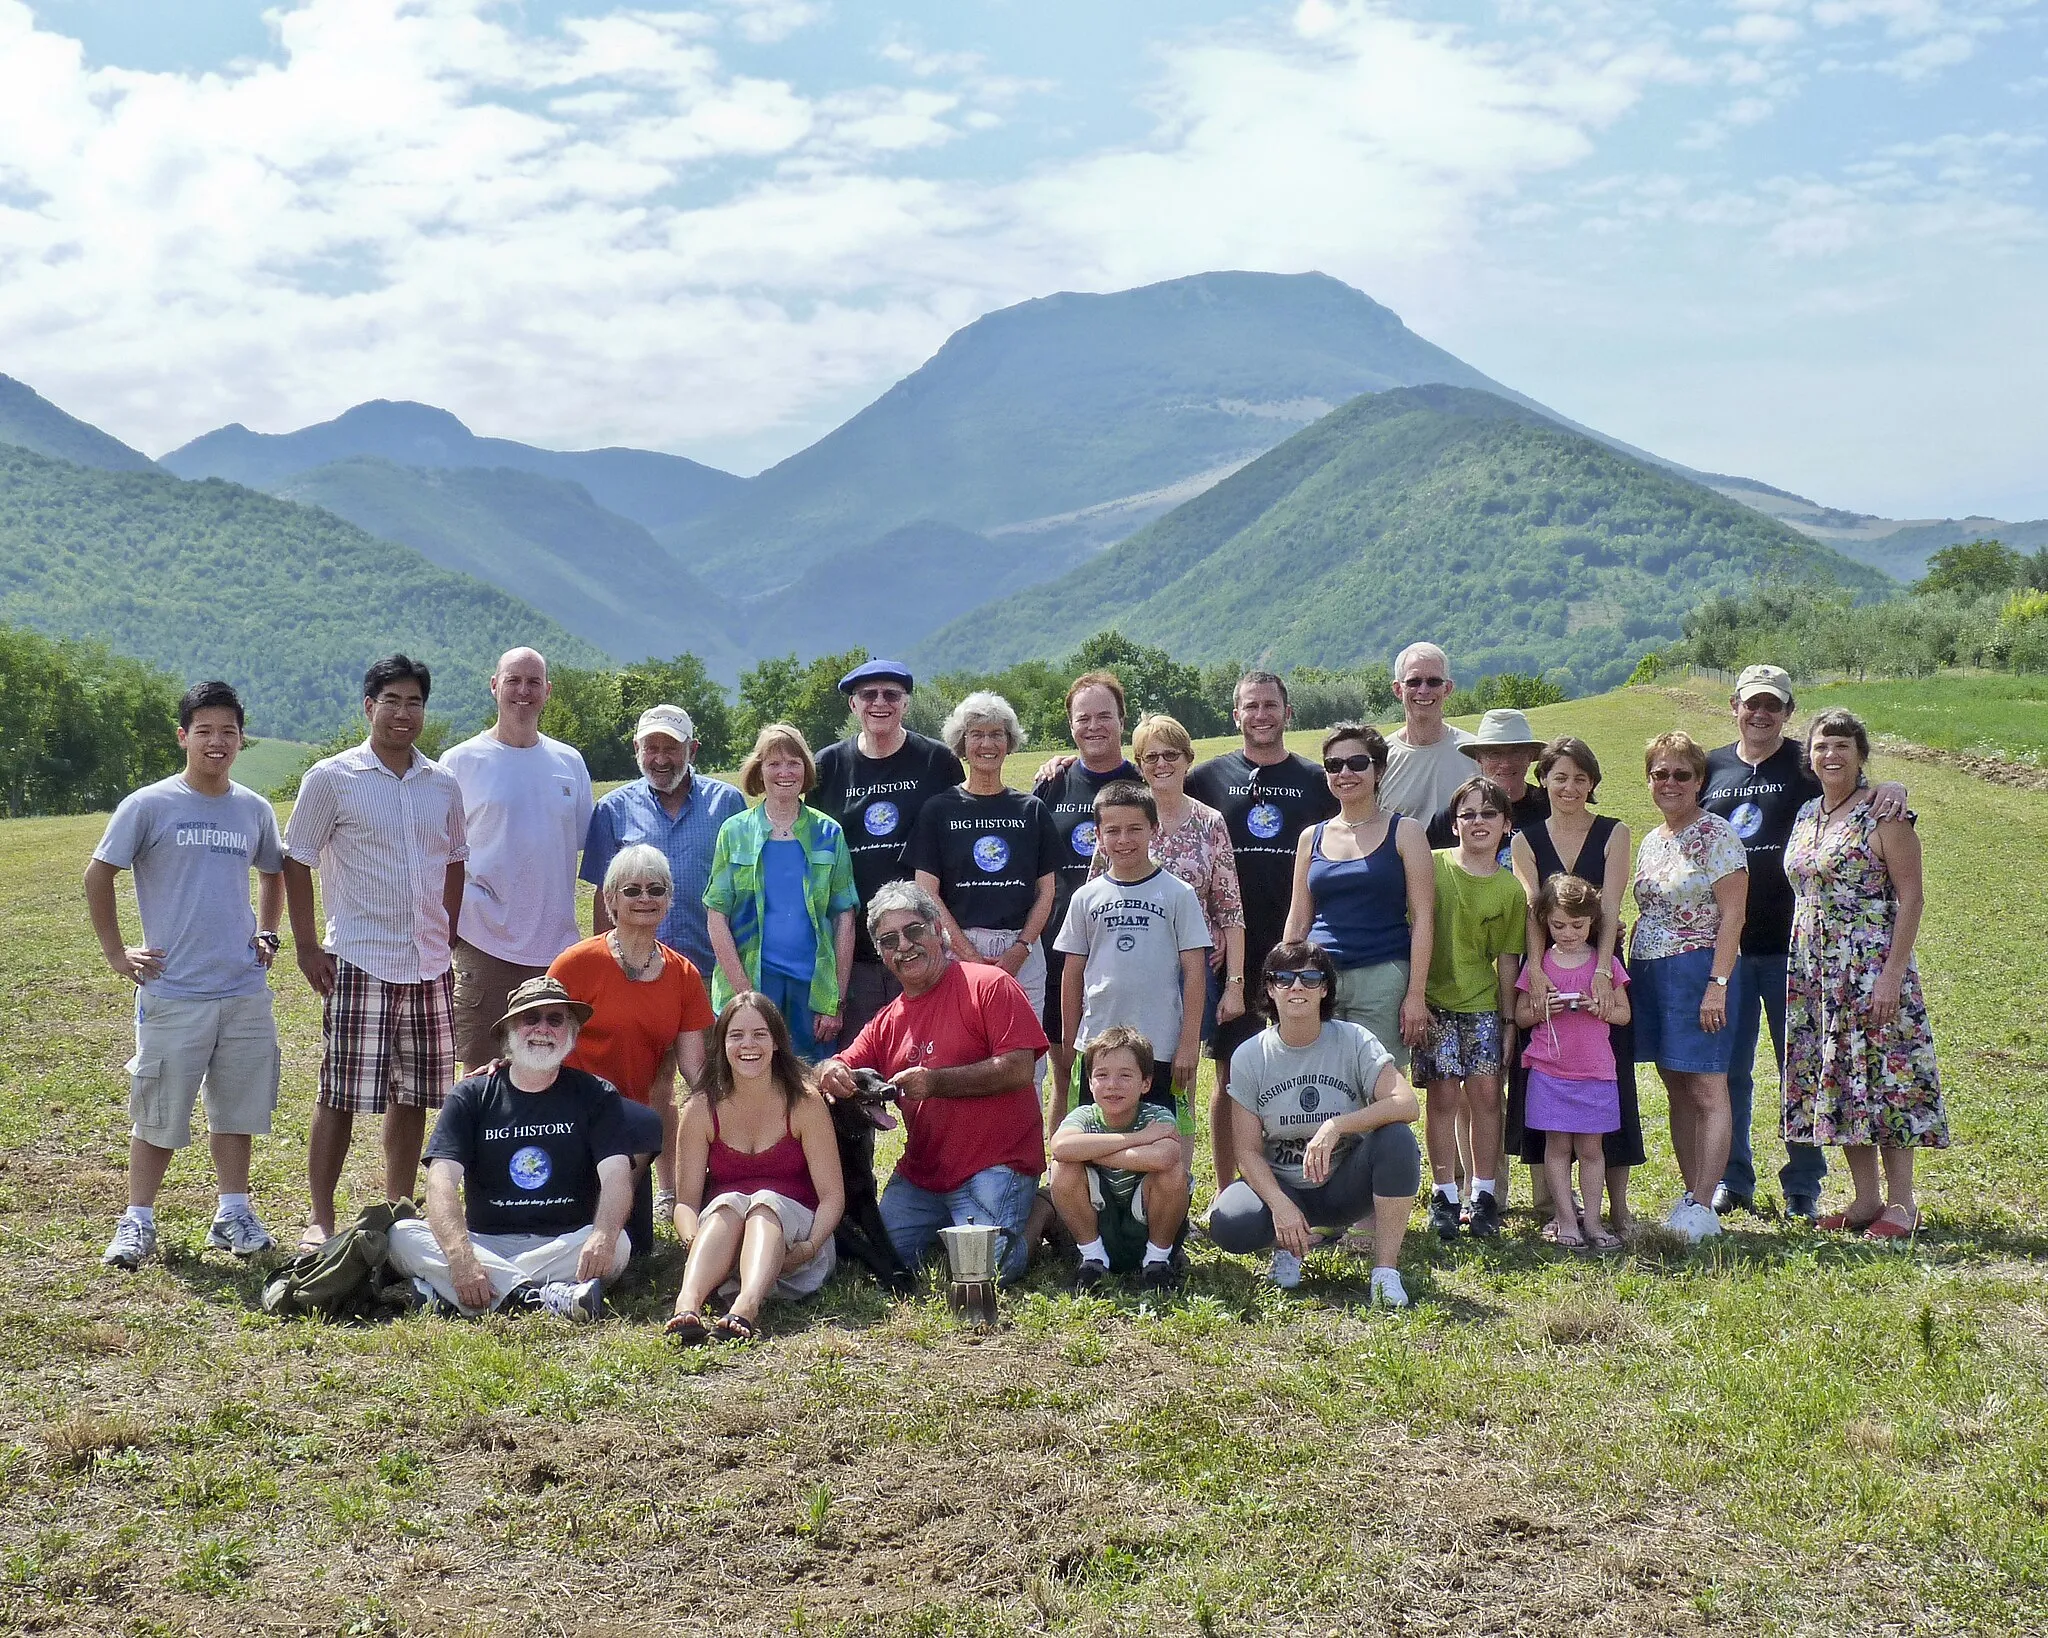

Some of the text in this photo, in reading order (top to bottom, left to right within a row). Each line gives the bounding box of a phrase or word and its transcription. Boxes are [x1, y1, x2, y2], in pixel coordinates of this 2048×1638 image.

[846, 780, 918, 798] BIG HISTORY
[1228, 786, 1249, 796] BIG
[1712, 783, 1786, 799] BIG HISTORY
[1055, 803, 1076, 813] BIG
[950, 818, 1026, 830] BIG HISTORY
[176, 829, 248, 851] CALIFORNIA
[1091, 899, 1166, 921] DODGEBALL
[1103, 915, 1150, 928] TEAM
[1280, 1115, 1289, 1126] DI
[485, 1122, 575, 1141] BIG HISTORY
